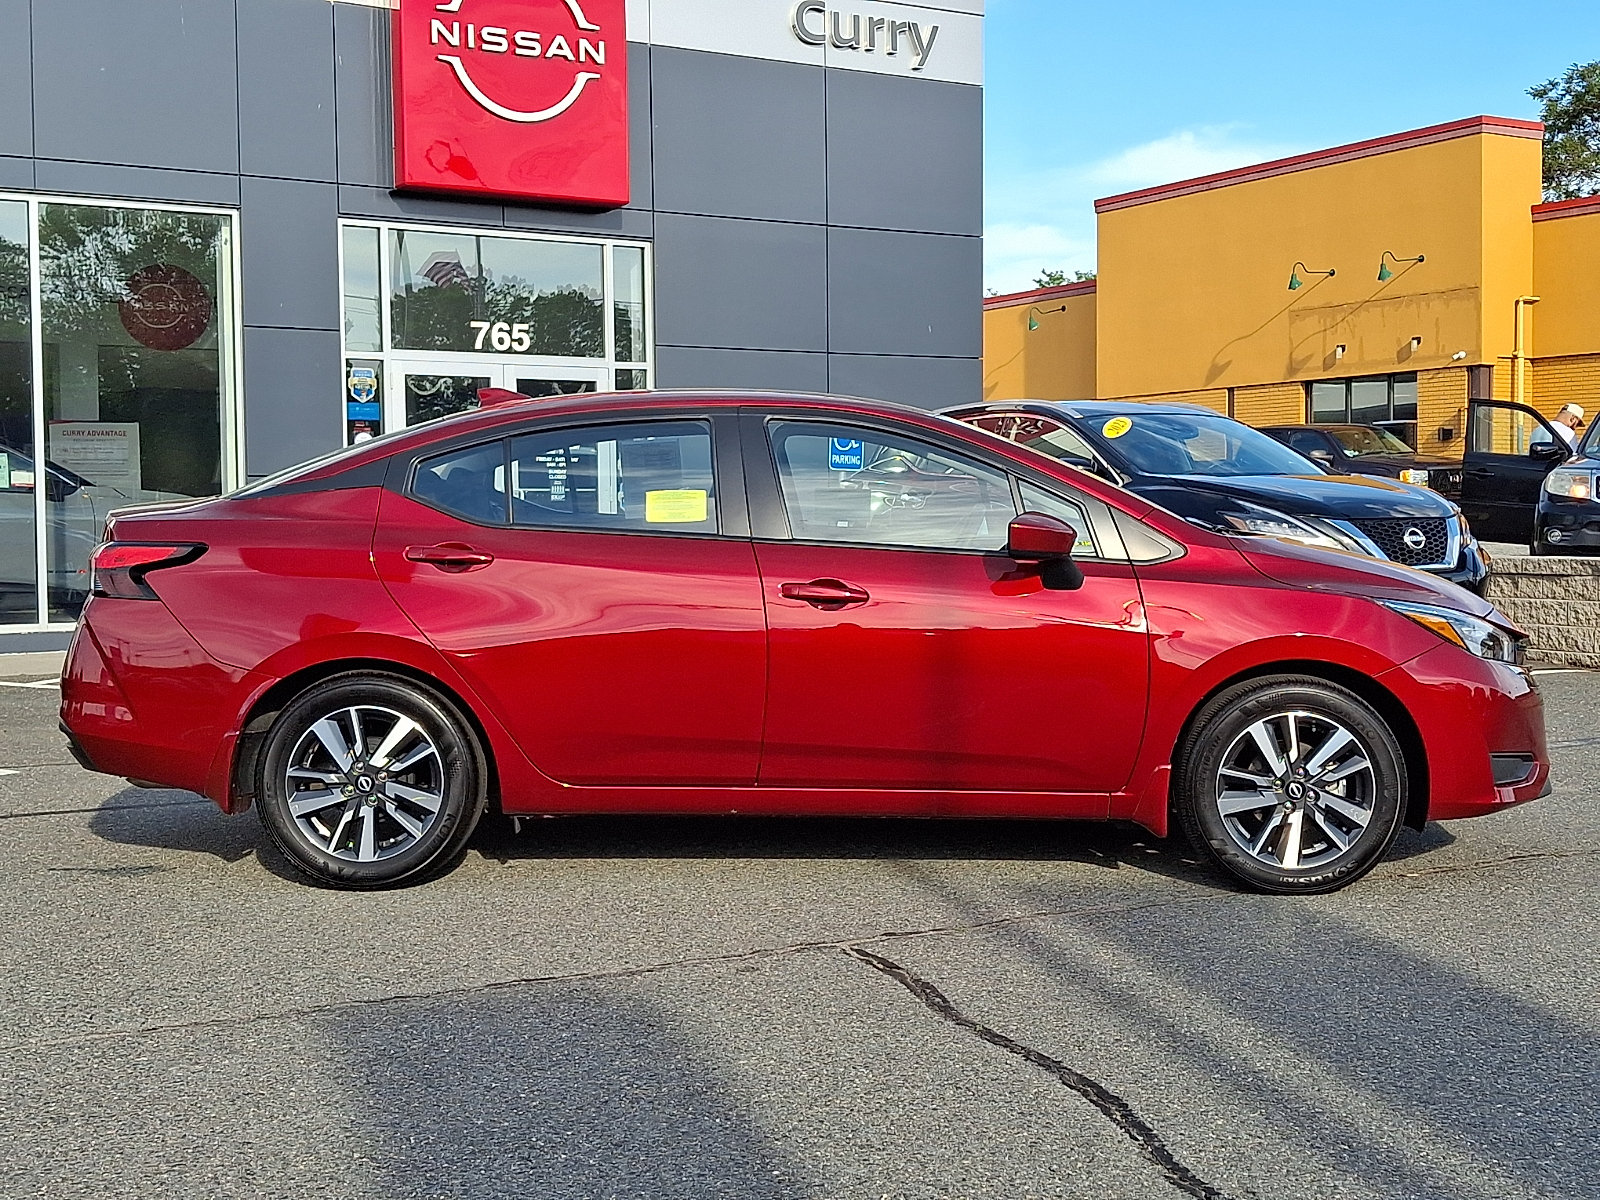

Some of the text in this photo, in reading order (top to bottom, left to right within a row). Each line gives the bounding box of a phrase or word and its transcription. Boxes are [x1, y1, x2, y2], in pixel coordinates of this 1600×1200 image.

[430, 18, 606, 65] NISSAN
[791, 0, 940, 71] Curry
[470, 321, 531, 352] 765
[832, 454, 861, 465] PARKING
